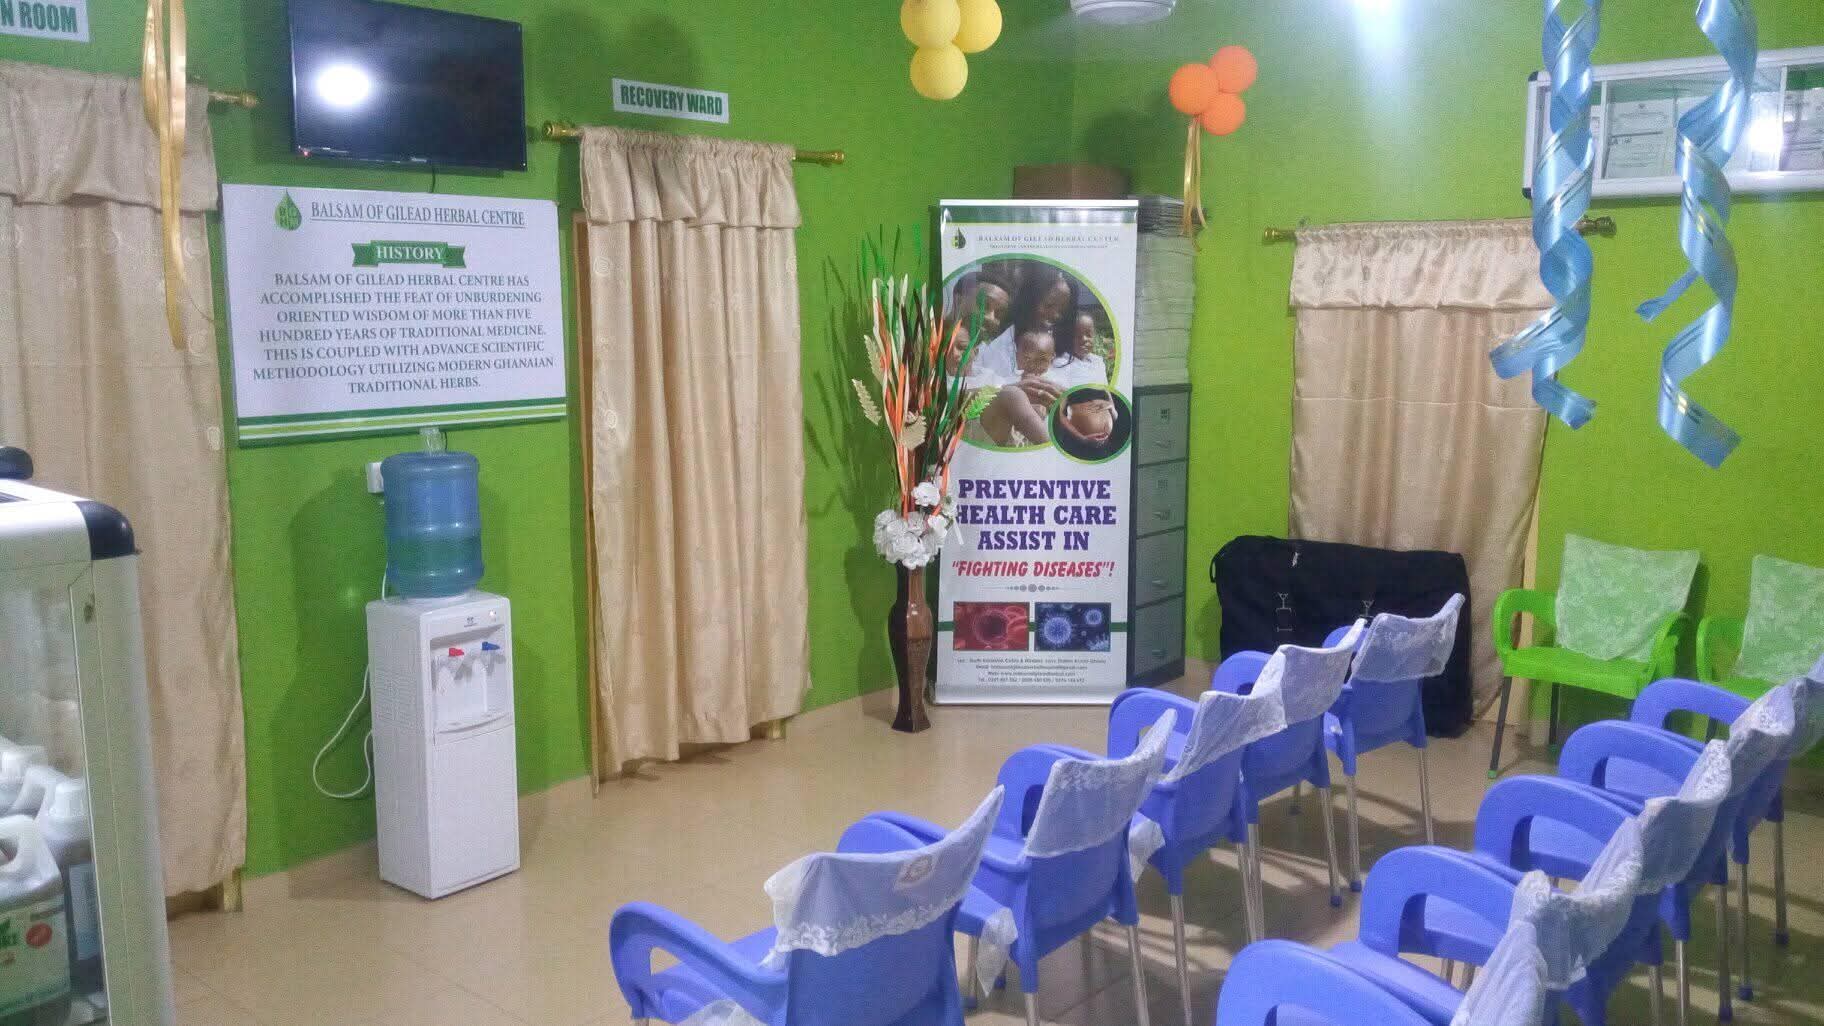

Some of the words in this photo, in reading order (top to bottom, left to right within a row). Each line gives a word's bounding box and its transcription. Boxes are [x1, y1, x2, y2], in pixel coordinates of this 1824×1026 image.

[18, 1, 78, 33] ROOM
[620, 84, 685, 111] RECOVERY
[686, 93, 723, 116] WARD
[311, 201, 363, 219] BALSAM
[367, 203, 383, 219] OF
[386, 205, 431, 221] GILEAD
[434, 207, 480, 224] HERBAL
[481, 209, 525, 226] CENTRE
[376, 245, 445, 261] HISTORY
[274, 273, 331, 286] BALSAM
[334, 274, 353, 286] OF
[355, 274, 404, 286] GILEAD
[407, 274, 456, 286] HERBAL
[458, 274, 505, 287] CENTRE
[507, 275, 530, 287] HAS
[260, 291, 372, 305] ACCOMPLISHED
[374, 291, 401, 304] THE
[404, 291, 433, 304] FEAT
[436, 291, 453, 304] OF
[455, 291, 542, 303] UNBURDENING
[276, 310, 350, 324] ORIENTED
[352, 310, 410, 322] WISDOM
[412, 310, 430, 321] OF
[432, 309, 468, 321] MORE
[470, 308, 504, 320] THAN
[506, 308, 532, 320] FIVE
[259, 328, 333, 343] HUNDRED
[335, 327, 377, 340] YEARS
[379, 327, 398, 339] OF
[399, 325, 485, 339] TRADITIONAL
[487, 324, 547, 337] MEDICINE.
[264, 348, 298, 361] THIS
[301, 347, 314, 360] IS
[316, 345, 381, 360] COUPLED
[383, 344, 420, 357] WITH
[422, 342, 480, 356] ADVANCE
[481, 340, 545, 354] SCIENTIFIC
[253, 363, 366, 380] METHODOLOGY
[368, 361, 436, 376] UTILIZING
[437, 359, 491, 373] MODERN
[493, 356, 555, 370] GHANAIAN
[348, 378, 438, 394] TRADITIONAL
[440, 376, 481, 390] HERBS.
[958, 479, 1111, 499] PREVENTIVE
[956, 505, 1045, 525] HEALTH
[1053, 505, 1117, 525] CARE
[977, 531, 1056, 551] ASSIST
[1063, 531, 1090, 551] IN
